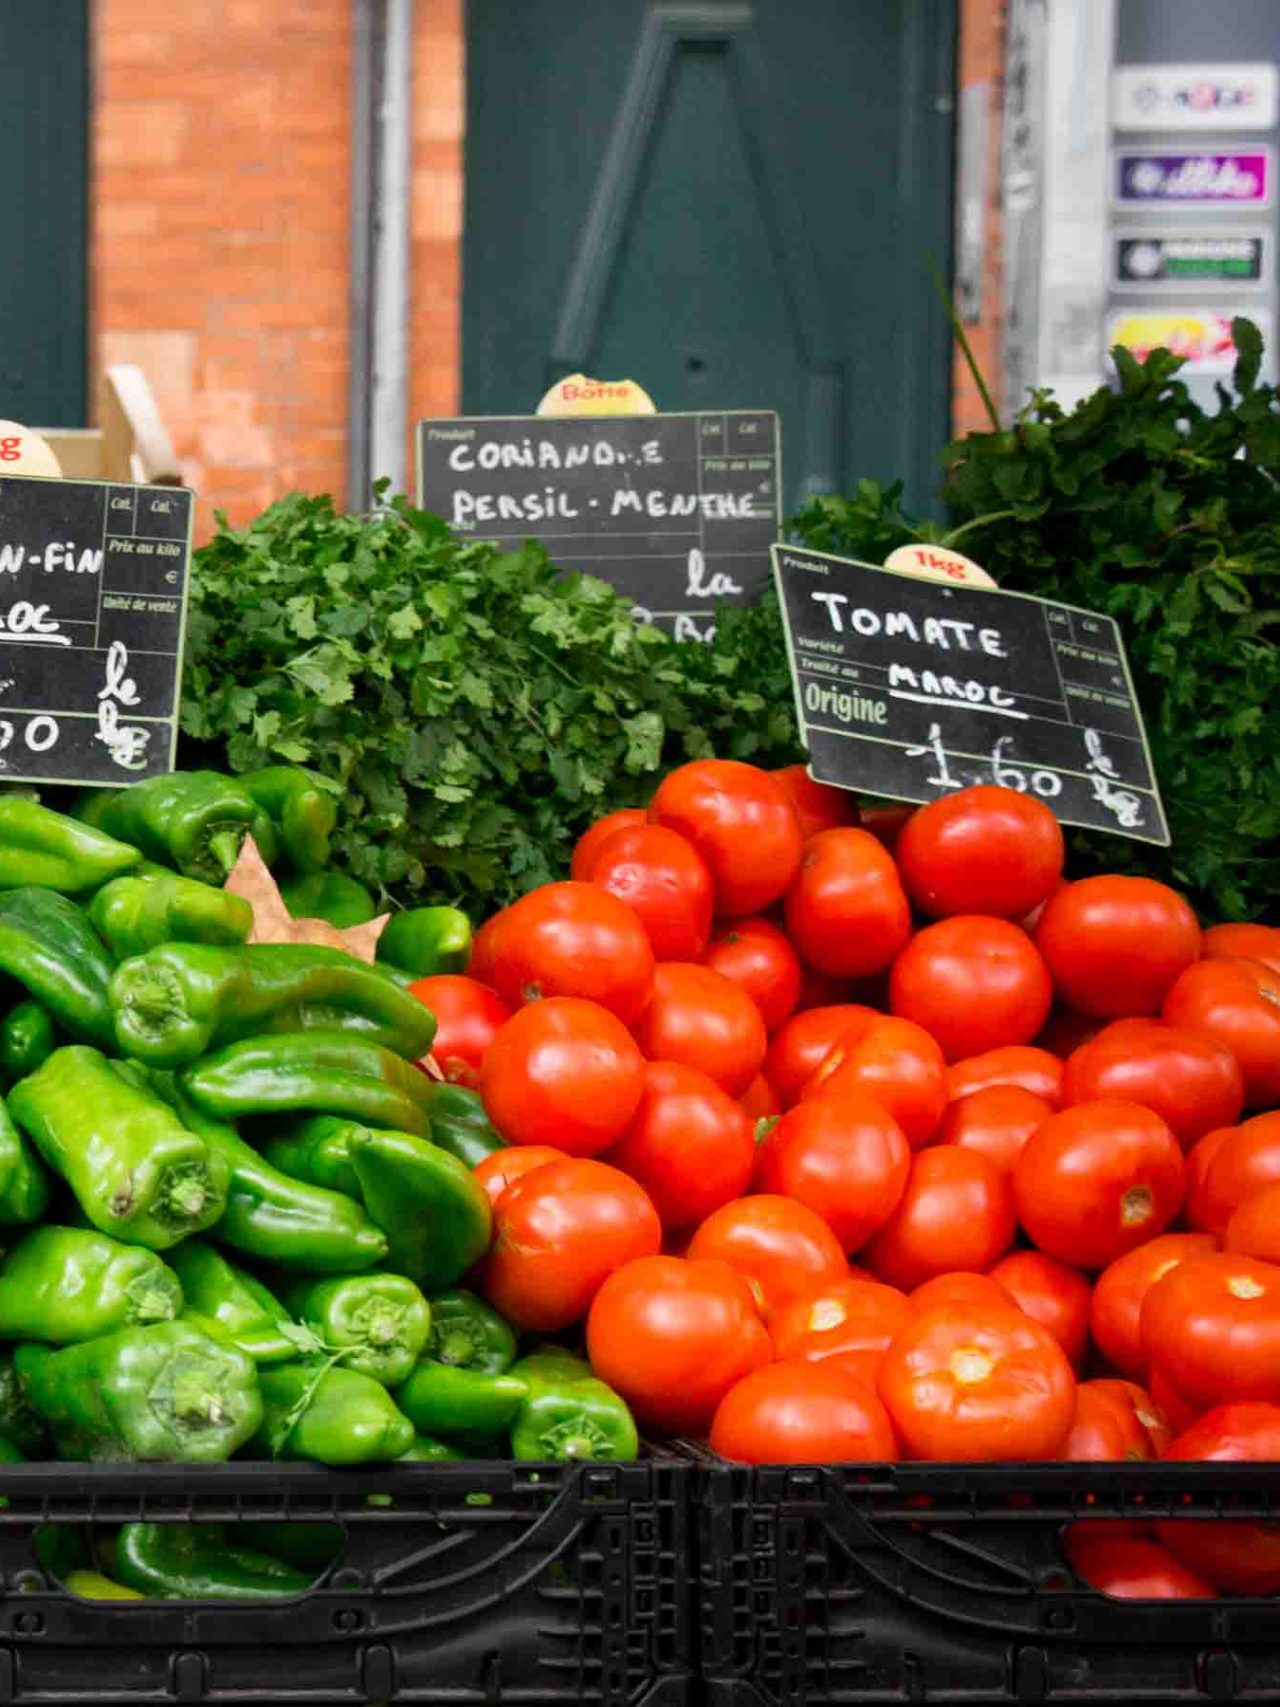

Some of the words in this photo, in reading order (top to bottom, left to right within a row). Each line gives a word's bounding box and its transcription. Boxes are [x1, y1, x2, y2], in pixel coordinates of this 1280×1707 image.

[108, 540, 135, 553] Prix
[136, 543, 155, 554] au
[156, 544, 181, 557] kilo
[914, 551, 967, 580] 1kg
[810, 591, 1009, 658] TOMATE
[805, 682, 888, 725] Origine
[888, 662, 1016, 707] MAROC
